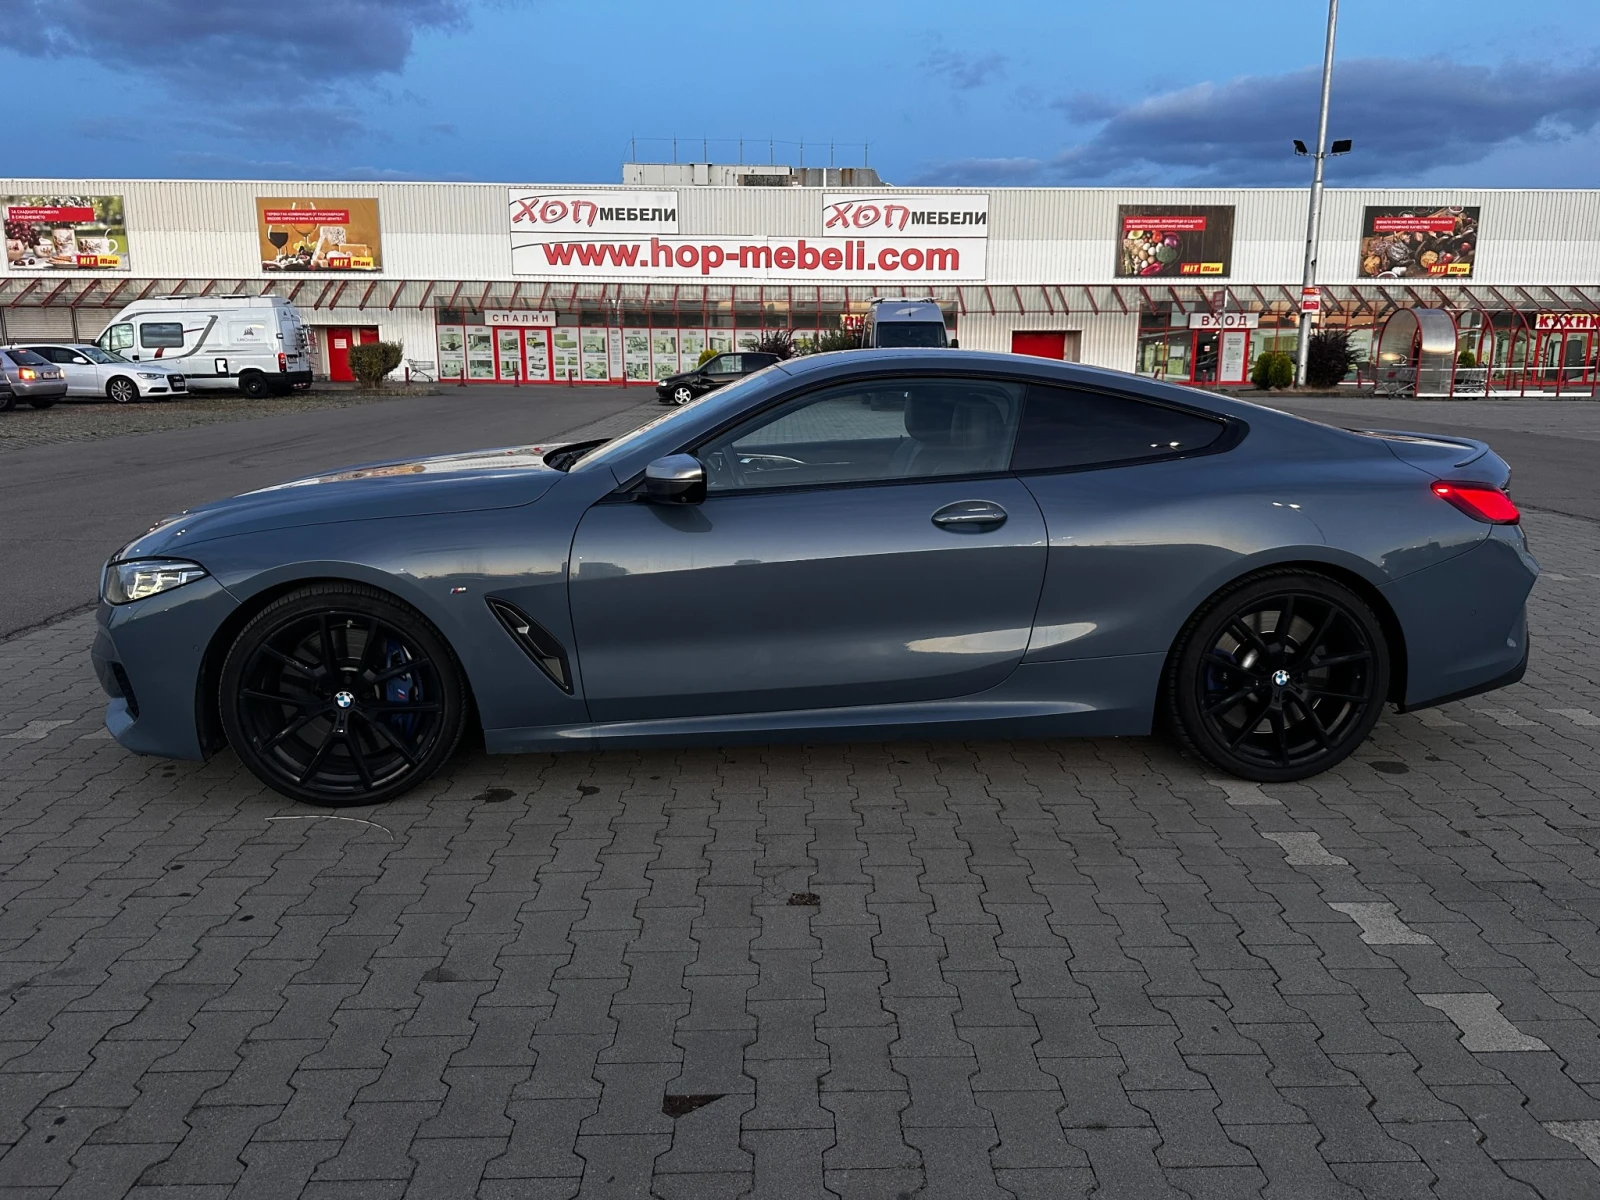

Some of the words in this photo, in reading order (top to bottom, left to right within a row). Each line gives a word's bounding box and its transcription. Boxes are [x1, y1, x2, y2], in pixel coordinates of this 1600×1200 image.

[600, 207, 676, 222] МЕБЕЛИ
[911, 211, 987, 225] МЕБЕЛИ
[80, 256, 96, 265] HIT
[542, 237, 960, 275] www.hop-mebeli.com
[333, 258, 349, 266] HIT
[1183, 264, 1199, 272] HIT
[492, 314, 549, 323] СПАЛНИ
[1201, 315, 1247, 327] ВХОД
